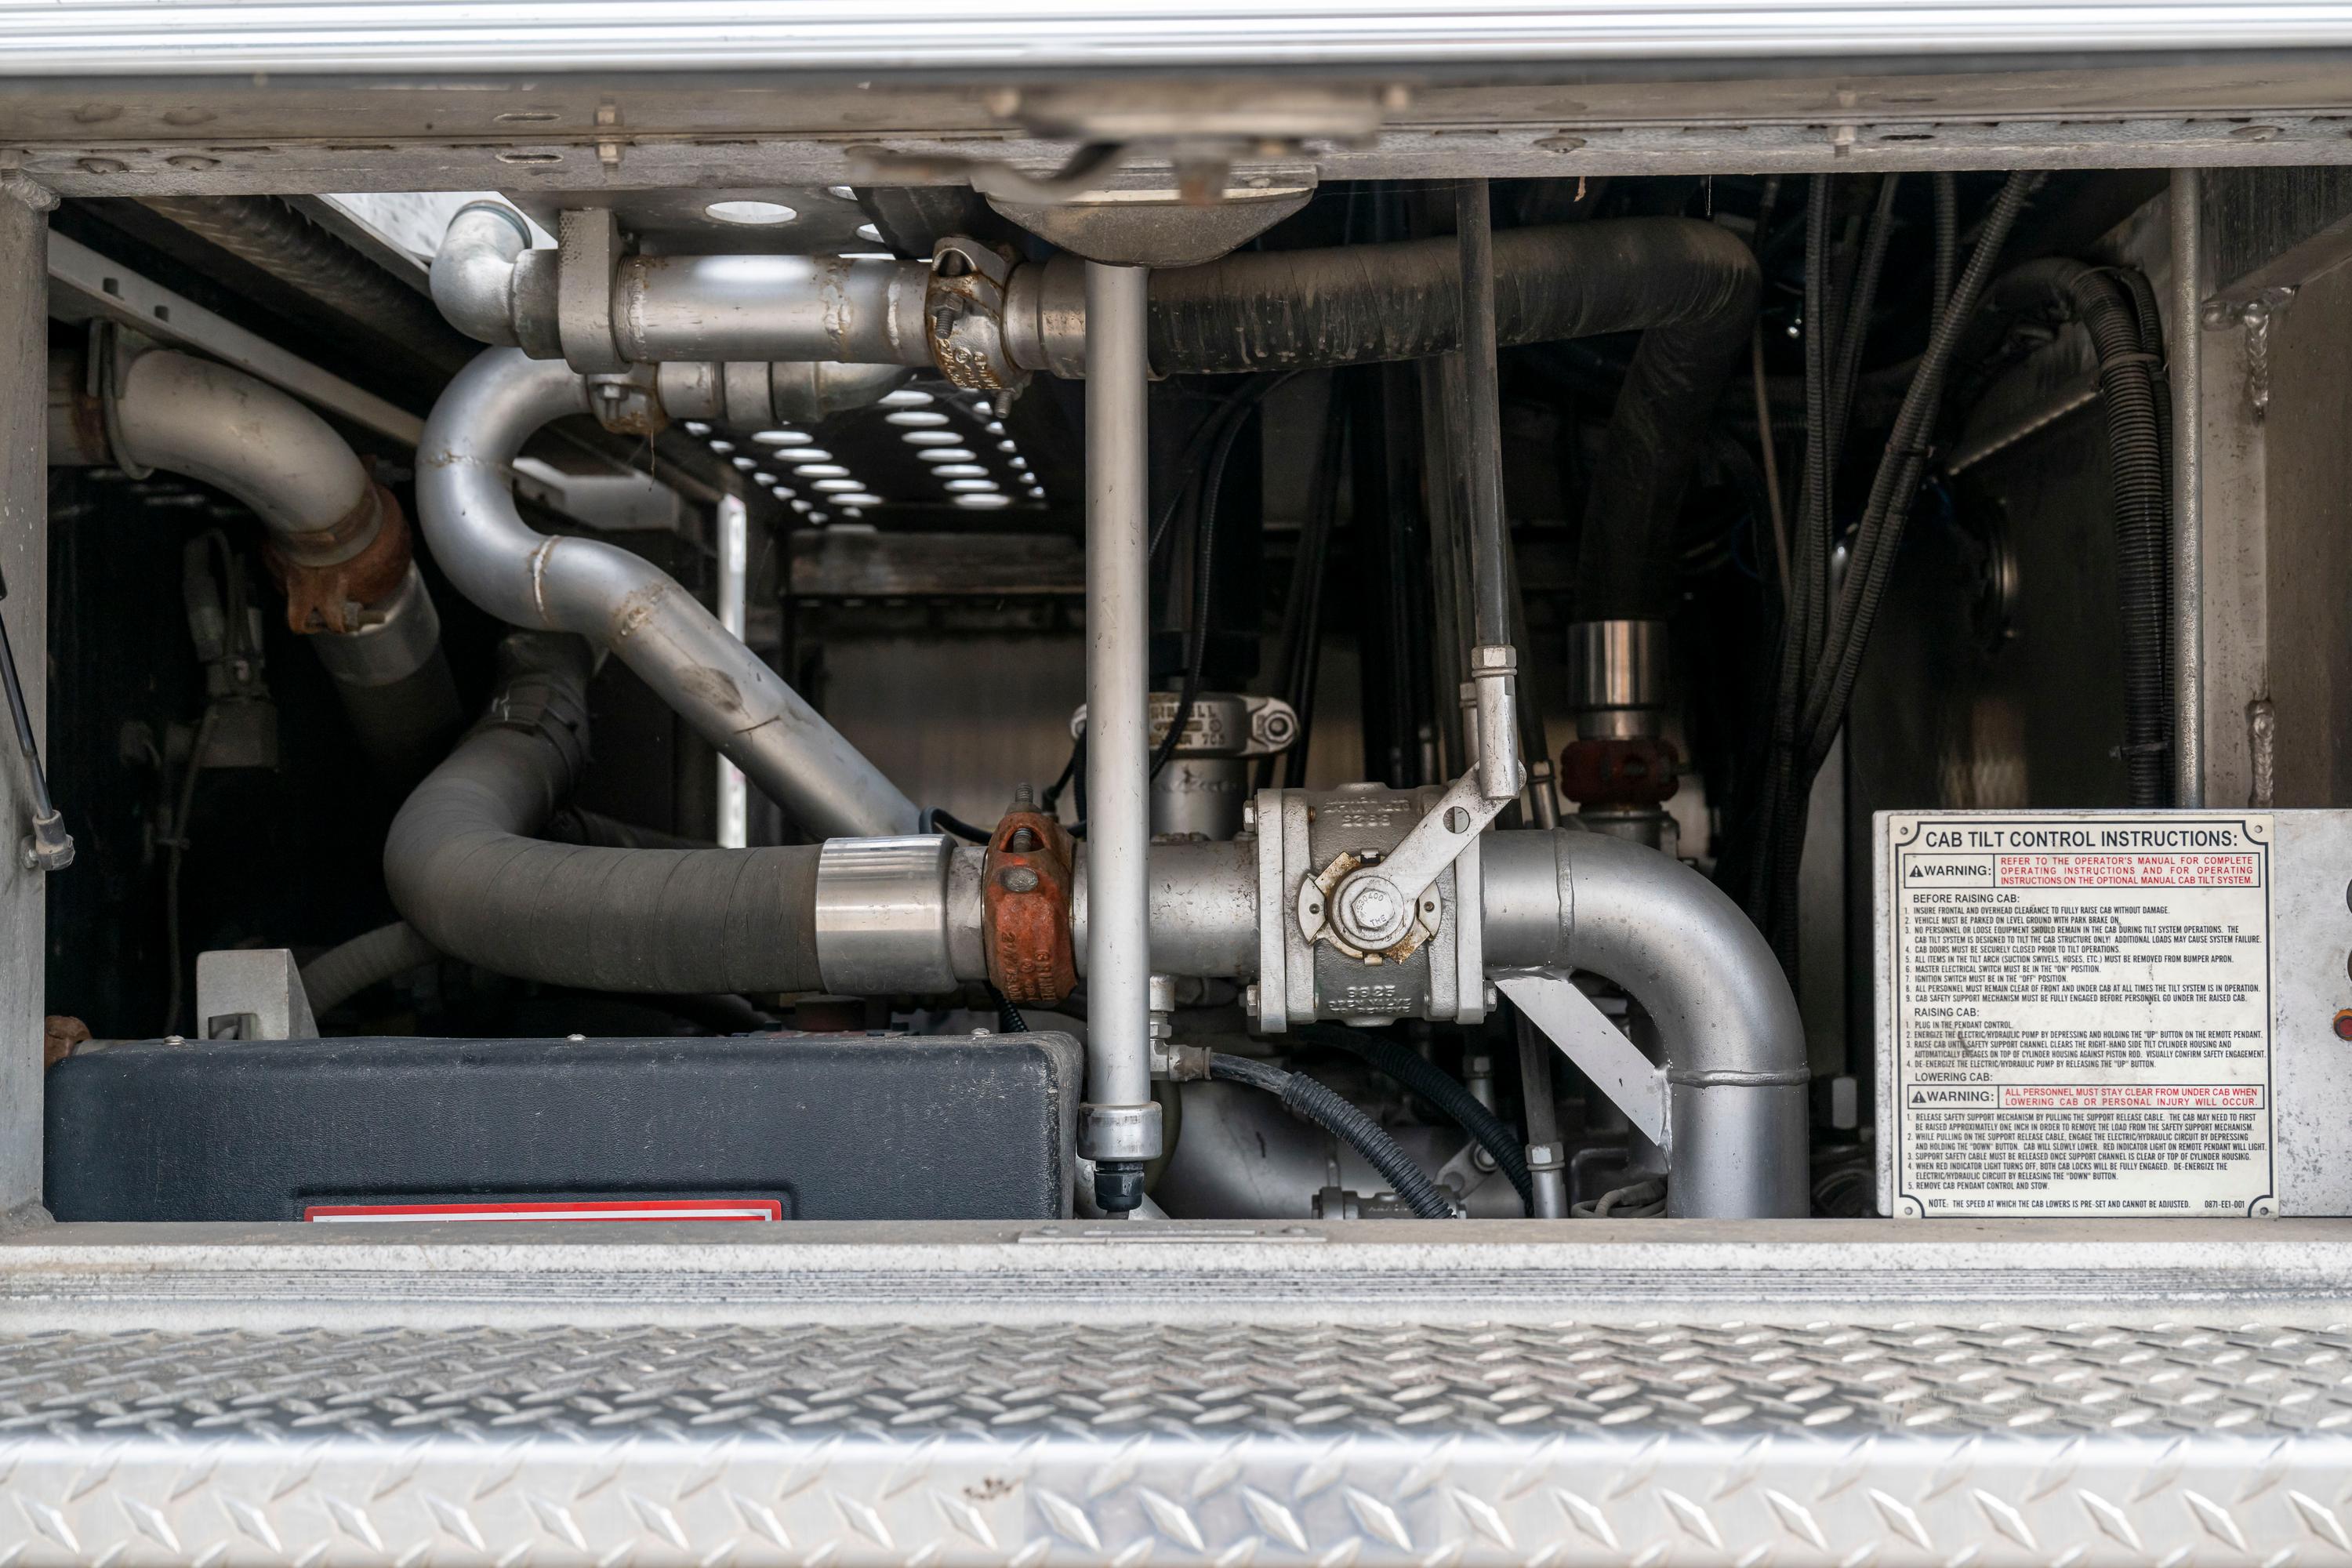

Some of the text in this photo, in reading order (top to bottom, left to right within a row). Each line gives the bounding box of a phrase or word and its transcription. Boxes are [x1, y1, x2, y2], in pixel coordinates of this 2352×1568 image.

[1926, 831, 2238, 848] CAB TILT CONTROL INSTRUCTIONS:
[1924, 866, 1991, 876] WARNING:
[1356, 891, 1385, 911] S30400
[1369, 914, 1387, 927] THE
[1915, 1073, 1993, 1081] LOWERING CAB:
[1926, 1091, 1994, 1102] WARNING:
